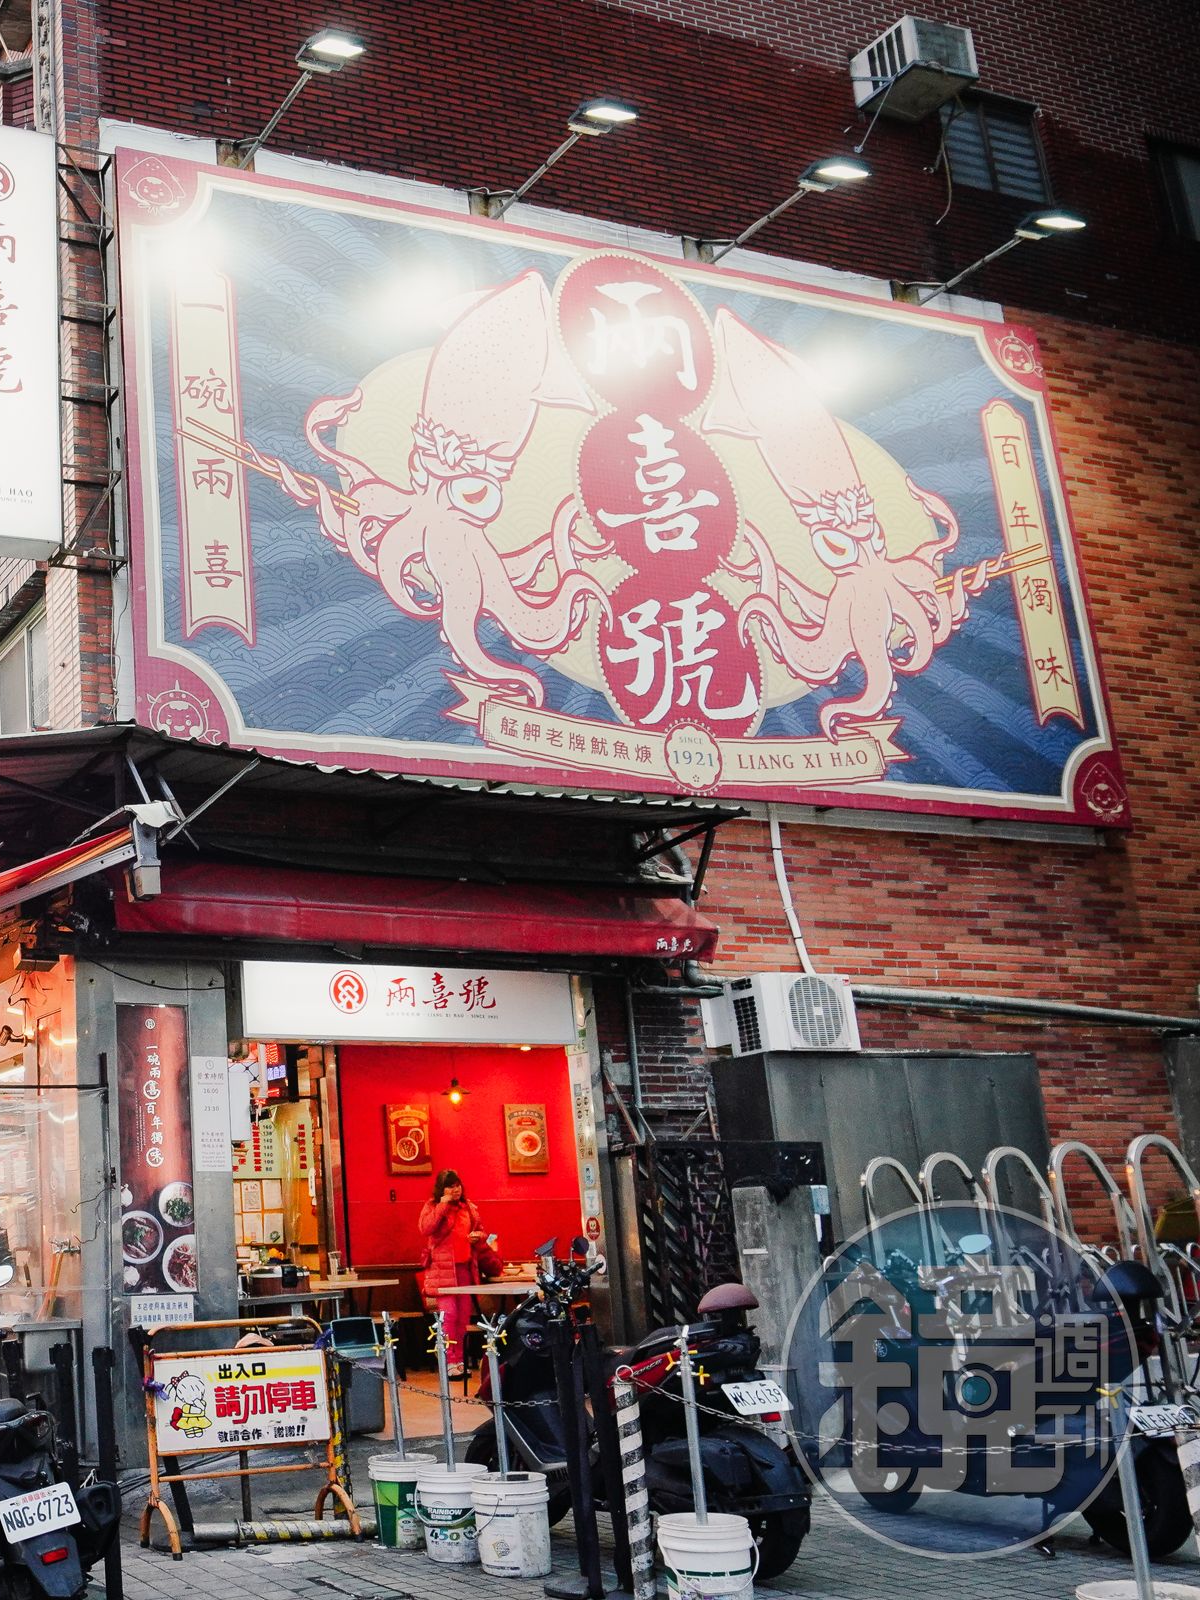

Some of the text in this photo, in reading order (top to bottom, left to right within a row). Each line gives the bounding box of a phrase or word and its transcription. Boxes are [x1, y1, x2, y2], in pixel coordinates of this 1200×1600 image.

[180, 302, 243, 588] 一碗兩喜
[9, 488, 33, 498] HAO
[586, 280, 759, 725] 兩喜號
[993, 433, 1074, 692] 百年獨味
[678, 735, 705, 746] SINCE
[672, 748, 716, 768] 1921
[737, 749, 869, 771] LIANG XI HAO
[385, 971, 497, 1012] 兩喜號
[218, 1362, 266, 1379] 出入口
[214, 1380, 318, 1425] 請勿停車
[2, 1493, 75, 1534] NQG-6723
[427, 1507, 463, 1516] RAINBOW
[430, 1528, 461, 1541] 450
